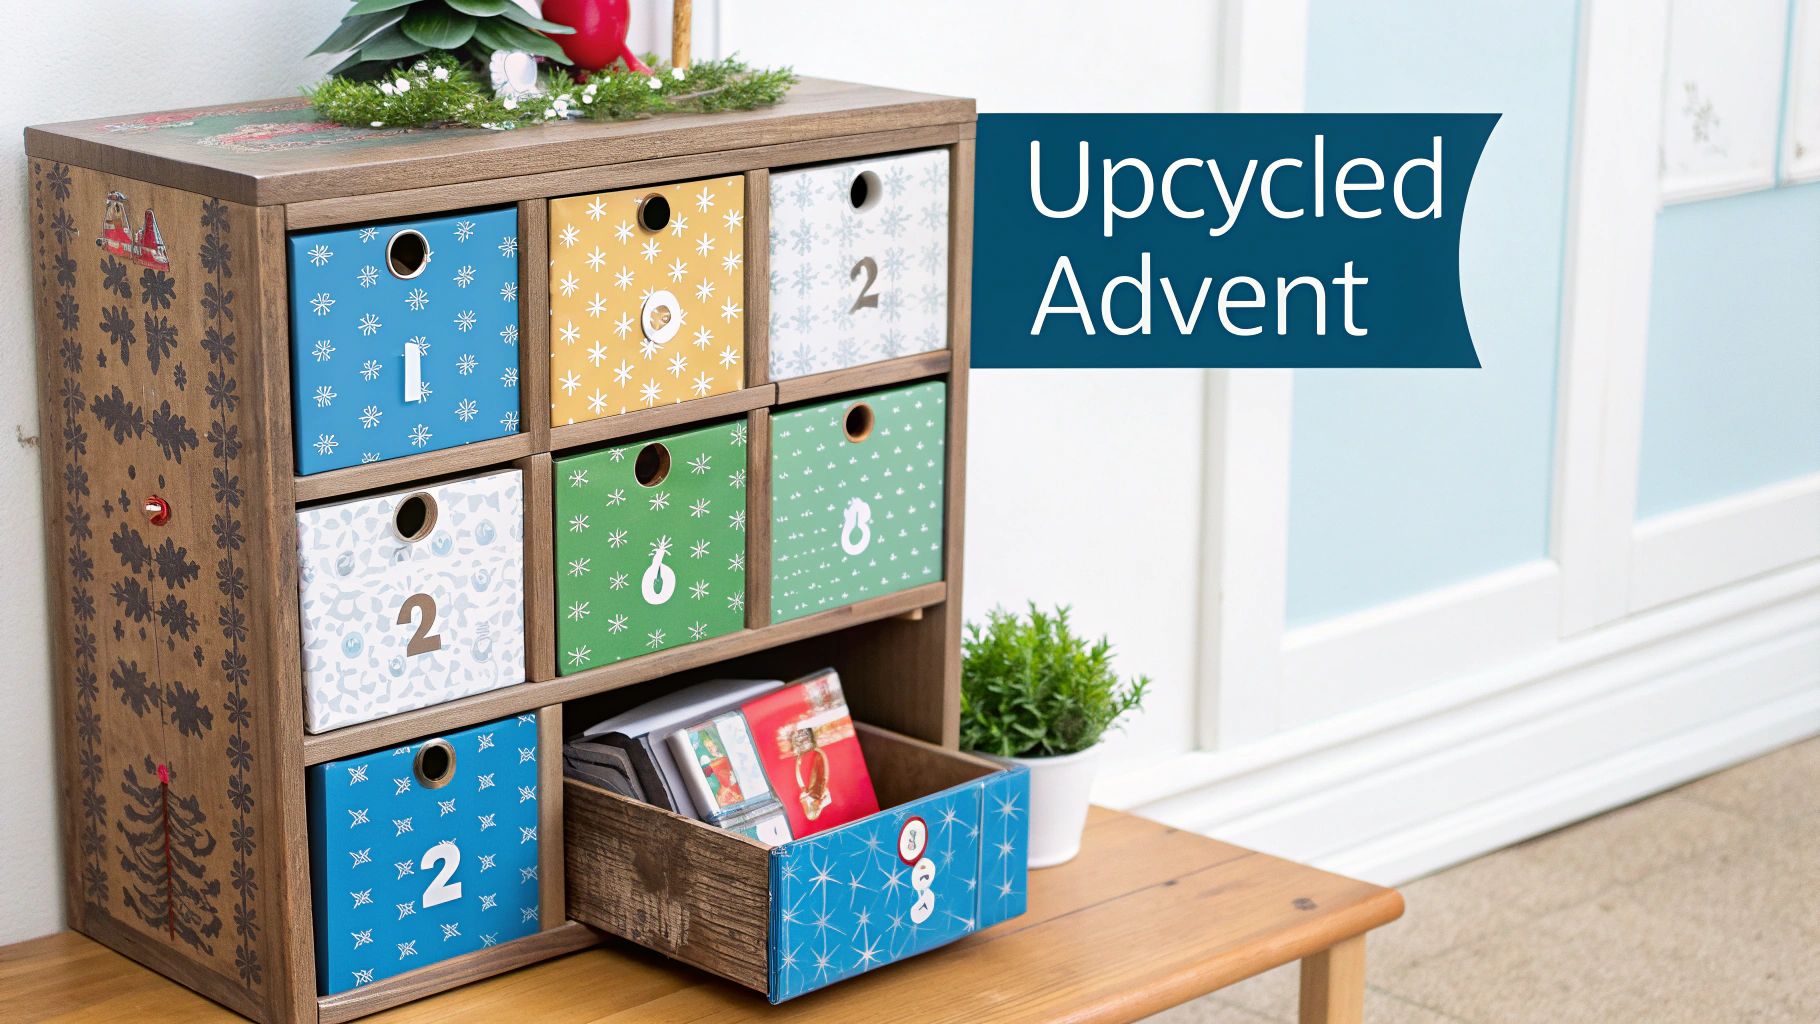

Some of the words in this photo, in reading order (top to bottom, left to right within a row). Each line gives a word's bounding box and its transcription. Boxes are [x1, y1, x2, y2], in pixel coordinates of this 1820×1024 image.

[850, 255, 880, 314] 2
[396, 593, 442, 658] 2
[420, 843, 462, 909] 2
